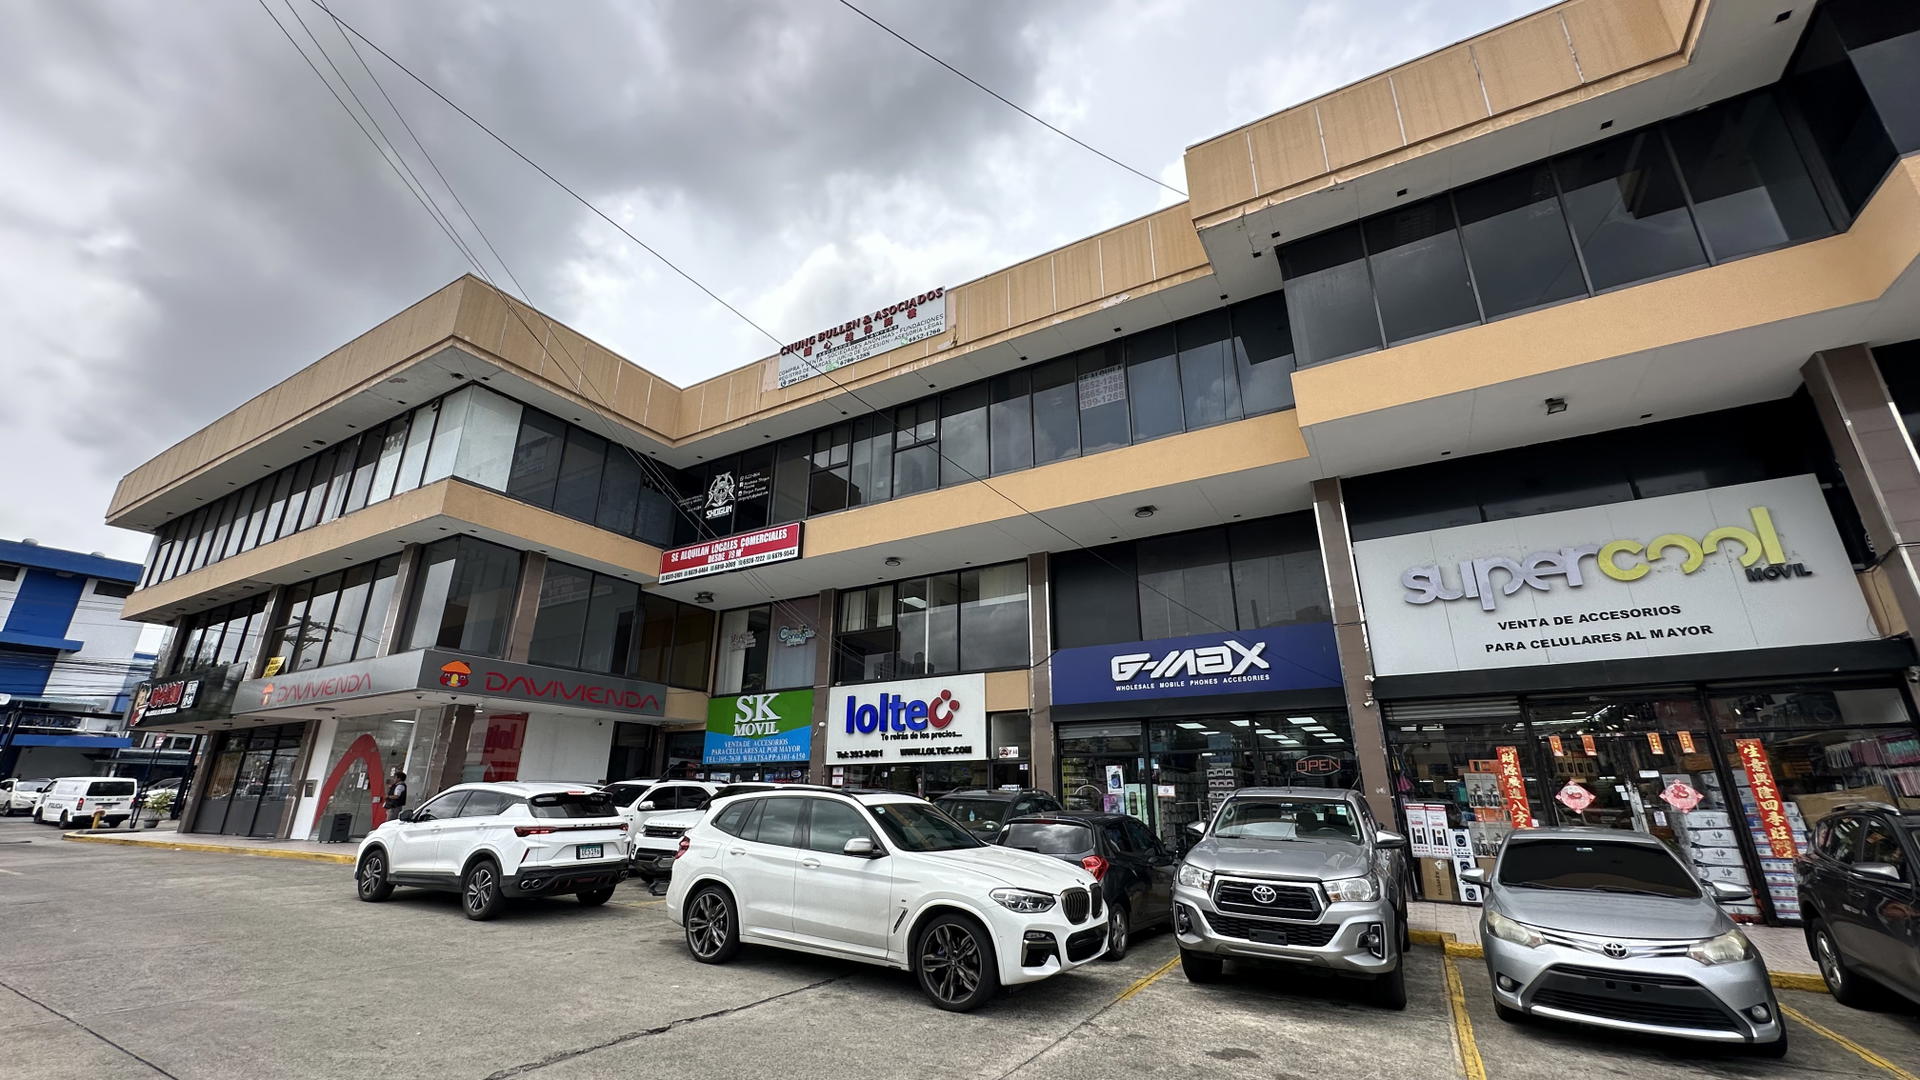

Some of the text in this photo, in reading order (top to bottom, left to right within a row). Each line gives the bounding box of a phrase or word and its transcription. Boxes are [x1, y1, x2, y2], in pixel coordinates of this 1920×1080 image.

[780, 335, 816, 356] CHUNG
[817, 318, 861, 342] BULLEN
[863, 315, 872, 325] &
[874, 287, 944, 321] ASOCIADOS
[899, 313, 944, 332] FUNDACIONES
[924, 320, 944, 331] LEGAL
[706, 505, 733, 519] SHOGUN
[671, 529, 788, 562] SE ALQUILAN LOCALES COMERCIALES
[707, 552, 726, 564] DESDE
[1745, 562, 1813, 583] MOVIL
[1497, 604, 1682, 630] VENTA DE ACCESORIOS
[1485, 624, 1714, 653] PARA CELULARES AL MAYOR
[277, 672, 372, 702] DAVIVIENDA
[485, 671, 660, 711] DAVIVIENDA
[1115, 673, 1270, 692] WHOLESALE MOBILE PHONES ACCESORIES
[734, 693, 782, 723] SK
[846, 689, 960, 734] loltec
[733, 721, 780, 737] MOVIL
[881, 733, 889, 741] Te
[910, 732, 919, 740] de
[919, 731, 930, 740] los
[724, 740, 742, 748] VENTA
[754, 738, 789, 746] ACCESORIOS
[726, 746, 758, 754] CELULARES
[1296, 758, 1341, 772] OPEN
[1743, 743, 1791, 841] 生意興隆四季旺
